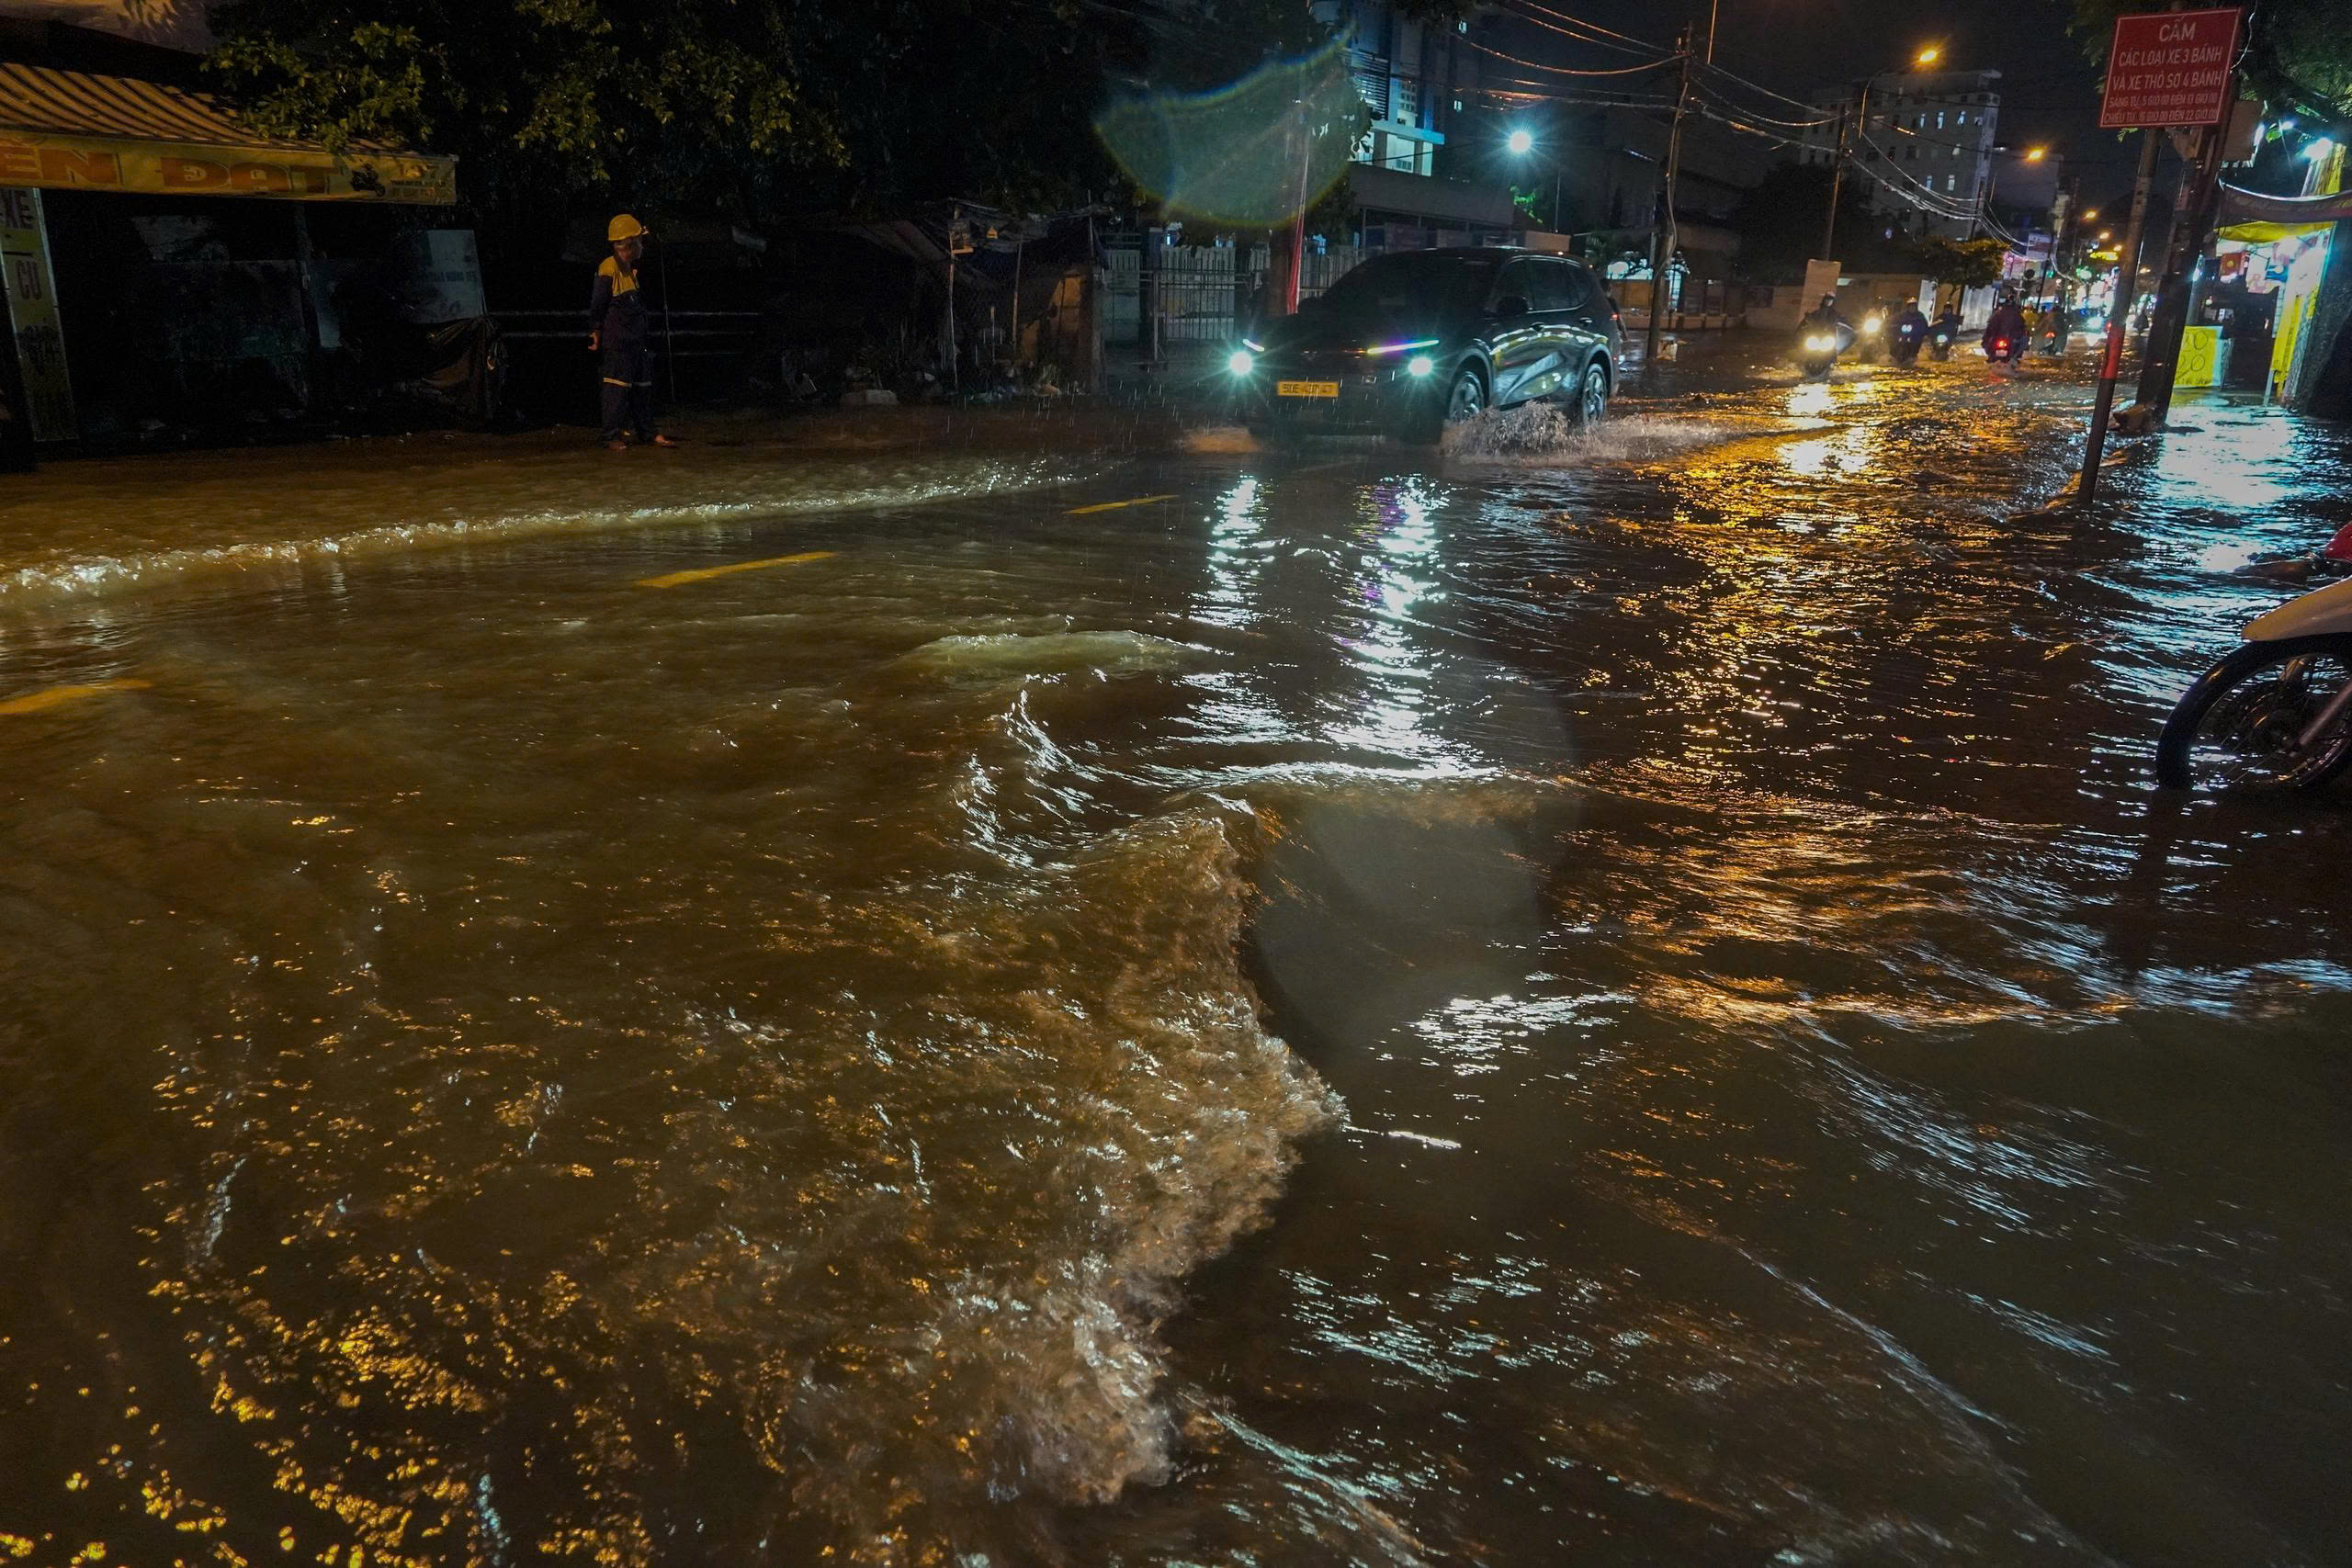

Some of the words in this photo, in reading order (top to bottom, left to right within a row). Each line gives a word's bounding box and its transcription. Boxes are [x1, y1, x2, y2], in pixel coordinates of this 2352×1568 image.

[2159, 16, 2197, 42] CẤM
[2119, 47, 2140, 66] CÁC
[2141, 49, 2166, 66] LOẠI
[2167, 49, 2182, 64] XE
[2183, 48, 2189, 62] 3
[2190, 43, 2223, 62] BÁNH
[2113, 73, 2125, 90] VÀ
[2127, 74, 2143, 90] XE
[2183, 73, 2190, 87] 4
[2190, 67, 2223, 87] BÁNH
